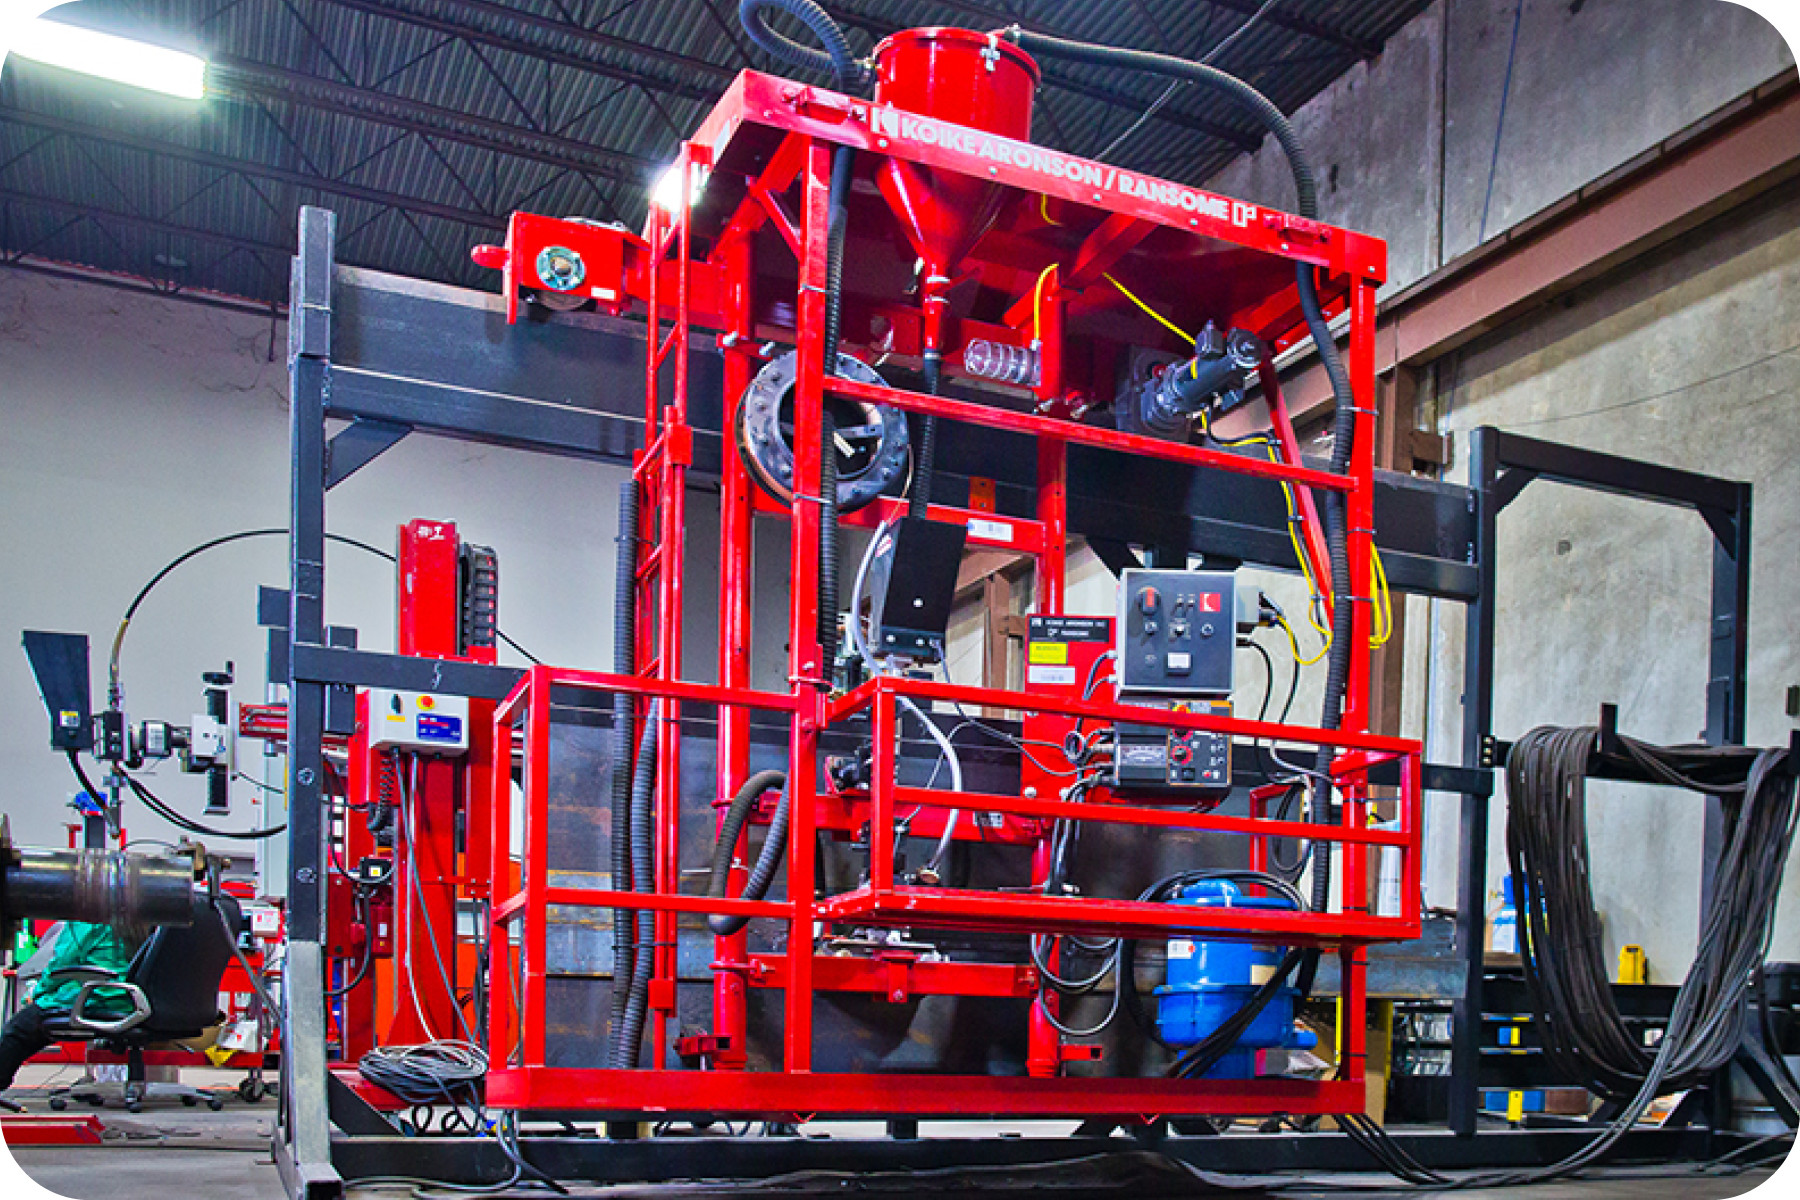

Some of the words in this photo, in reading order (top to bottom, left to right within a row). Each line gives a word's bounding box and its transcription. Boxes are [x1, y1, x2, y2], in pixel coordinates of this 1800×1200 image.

[901, 117, 976, 154] KOIKE
[978, 139, 1102, 187] ARONSON
[1118, 174, 1229, 221] RANSOME
